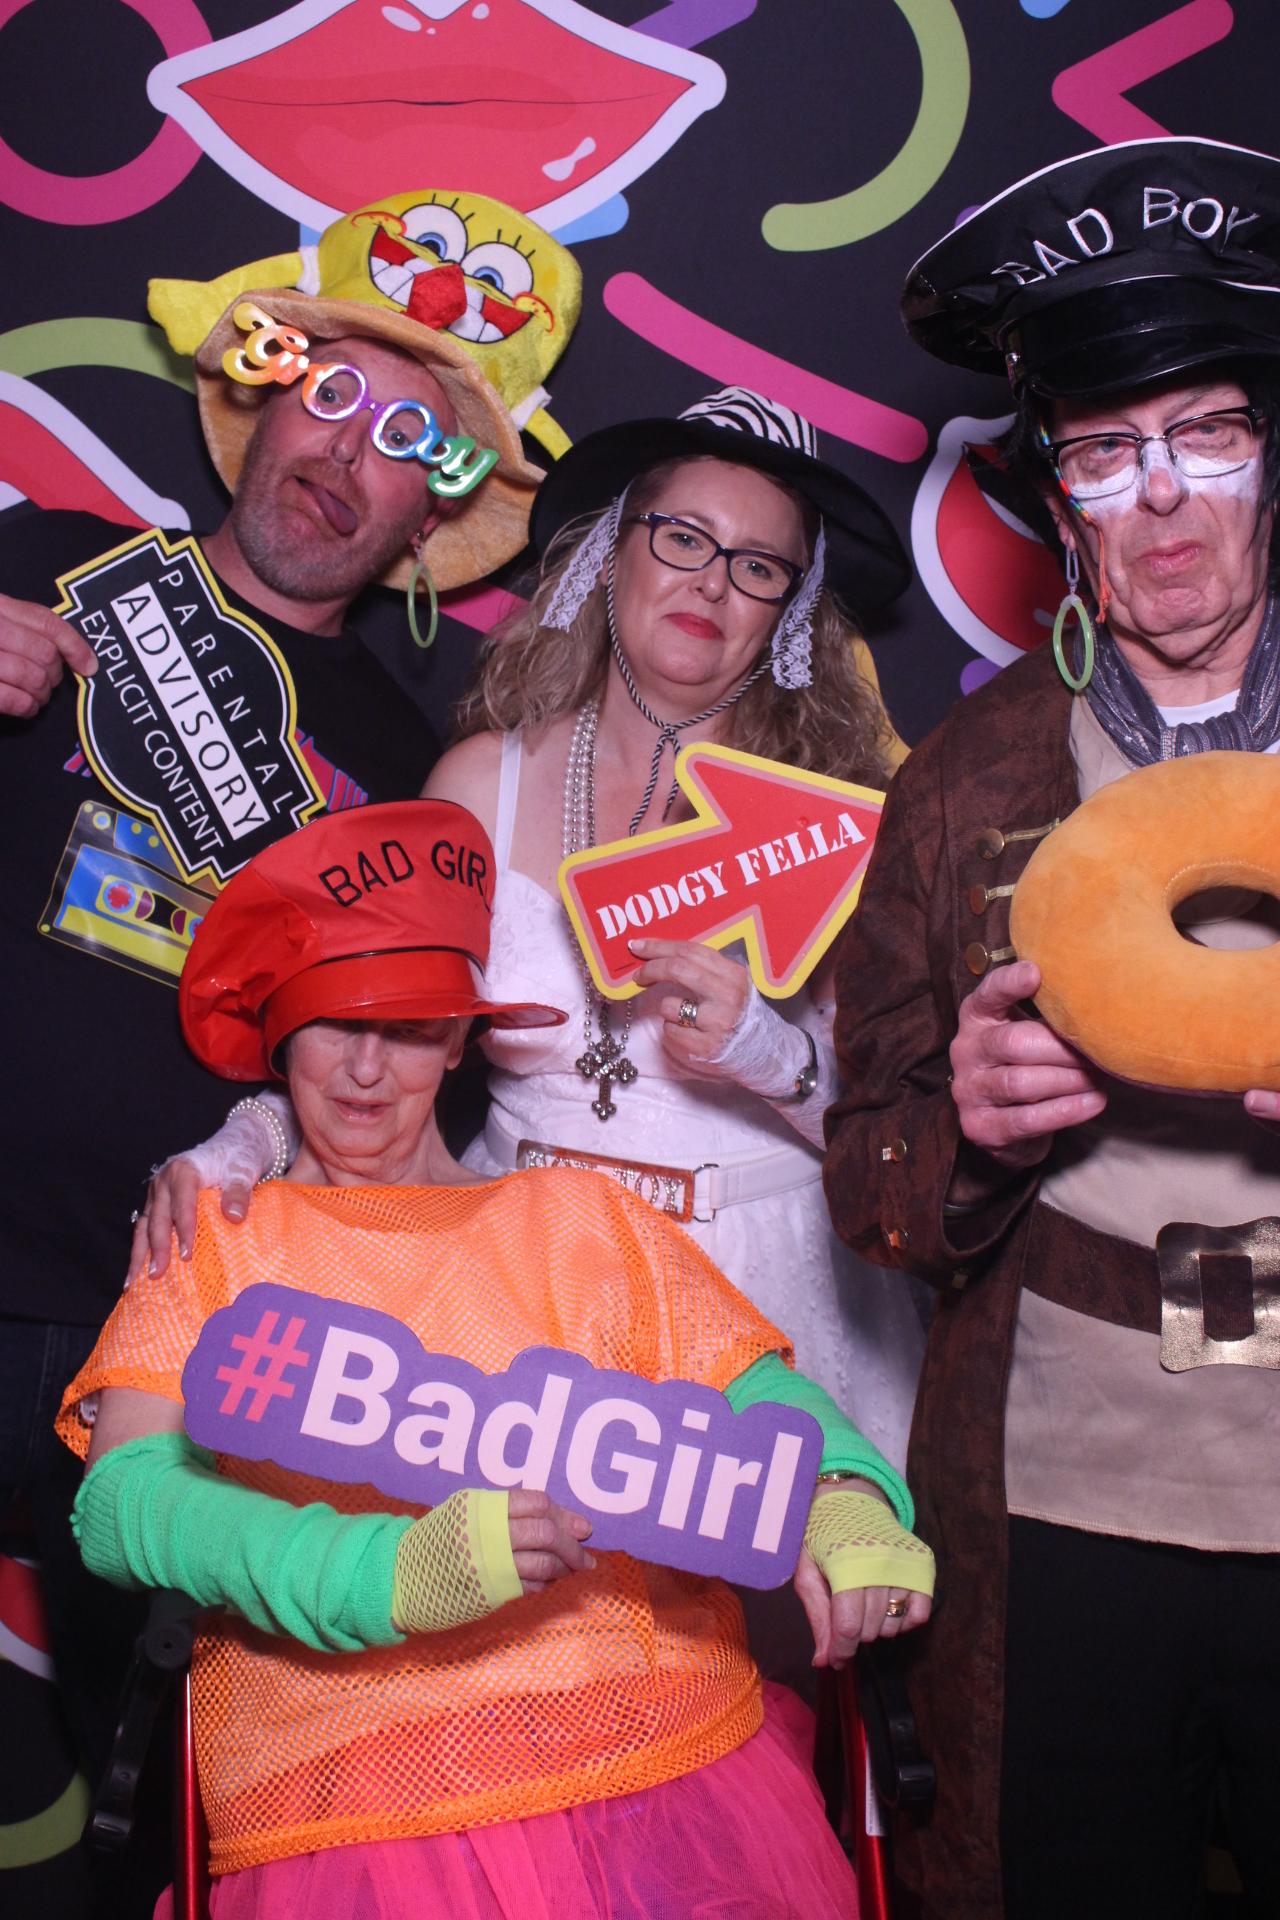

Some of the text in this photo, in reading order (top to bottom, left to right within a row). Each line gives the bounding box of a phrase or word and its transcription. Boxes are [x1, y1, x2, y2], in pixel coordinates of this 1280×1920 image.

[991, 186, 1261, 286] BAD BOY
[79, 609, 225, 852] EXPLICIT CONTENT
[116, 594, 266, 831] ADVISORY
[158, 567, 295, 815] PARENTAL
[318, 839, 491, 912] BAD GIR
[595, 812, 867, 941] DODGY FELLA
[215, 1309, 804, 1555] #BadGirl
